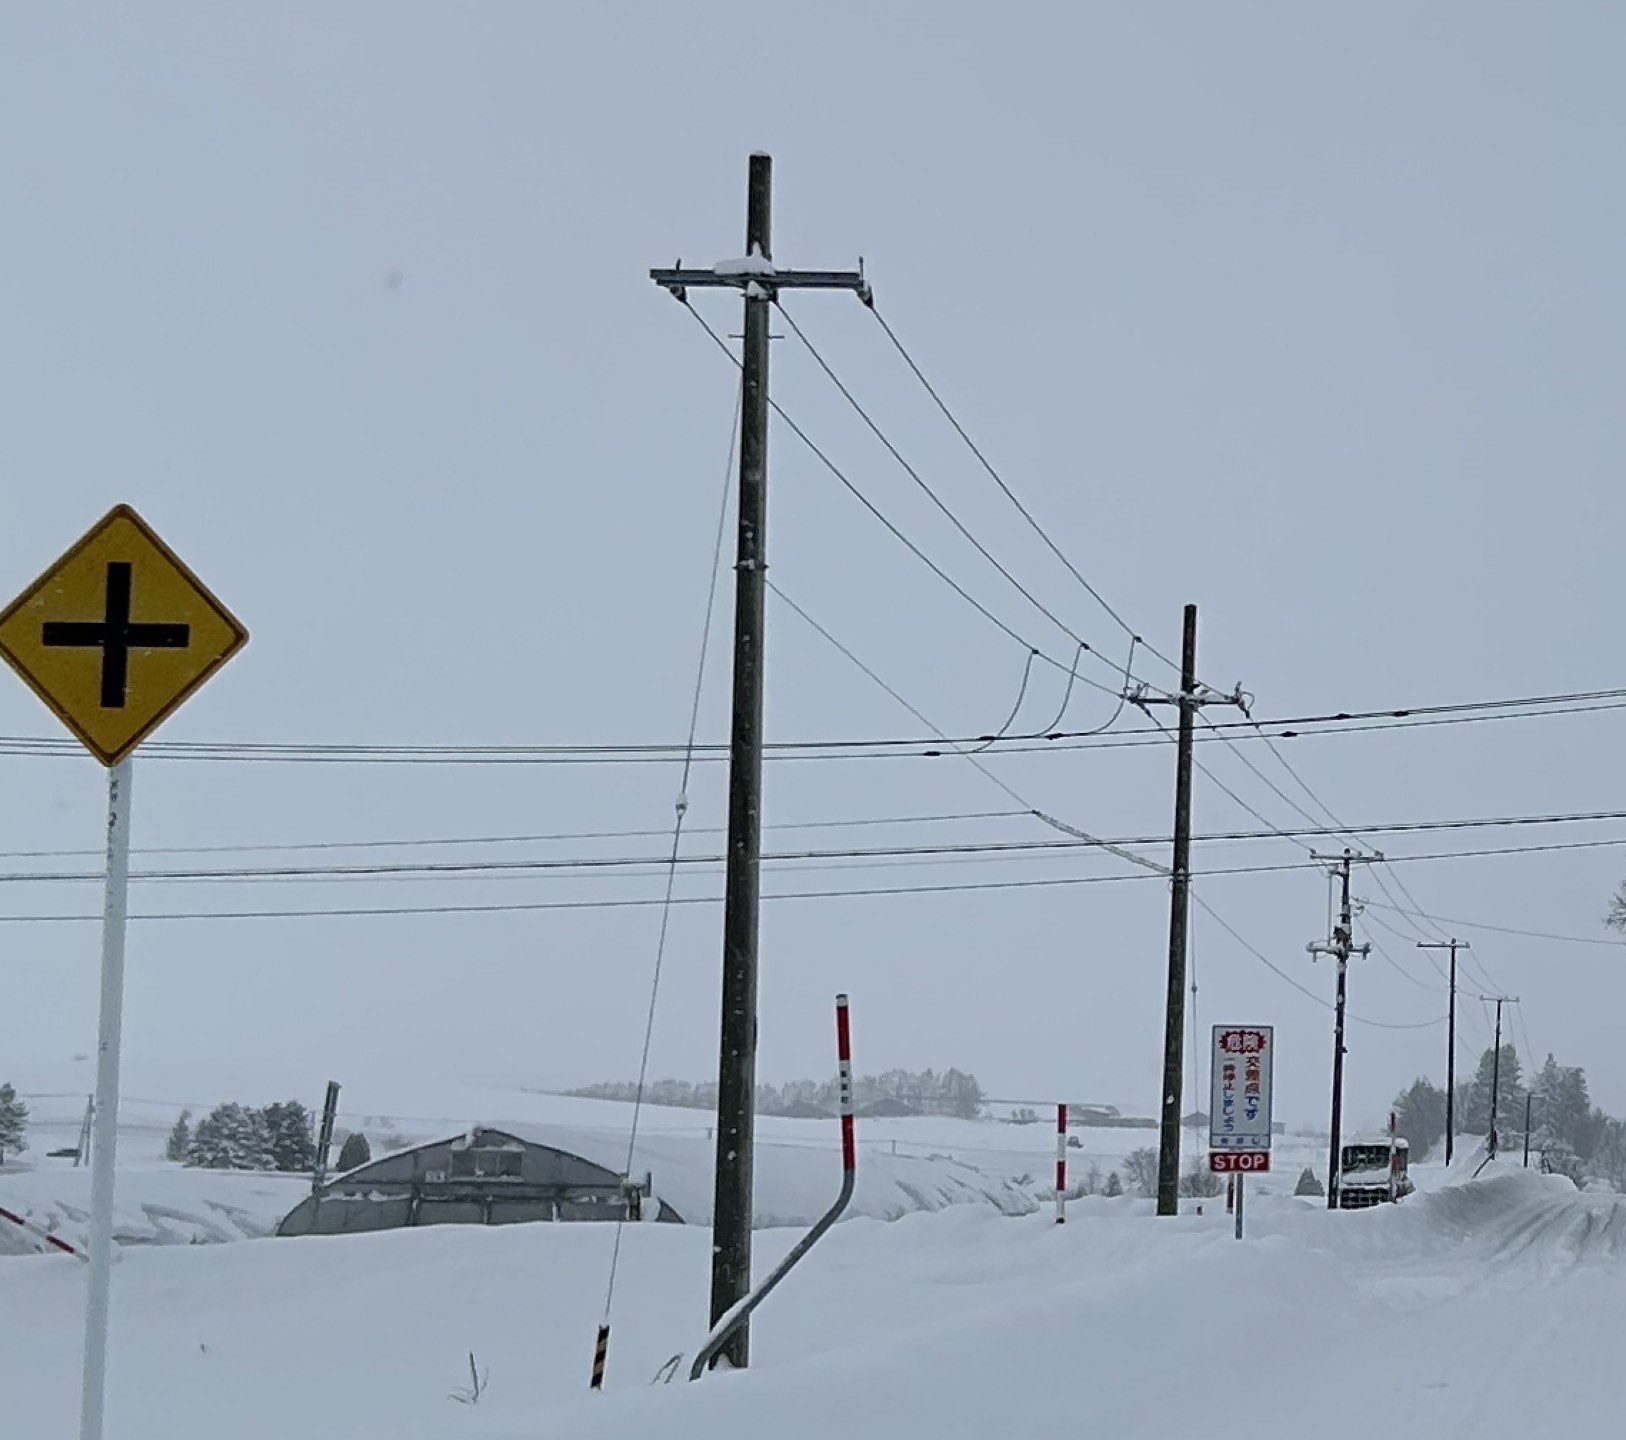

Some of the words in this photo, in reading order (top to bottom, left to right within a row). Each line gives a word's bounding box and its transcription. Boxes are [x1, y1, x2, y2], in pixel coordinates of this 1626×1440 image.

[1227, 1033, 1259, 1050] 危険
[1245, 1056, 1260, 1120] 交差点です
[1213, 1154, 1264, 1169] STOP
